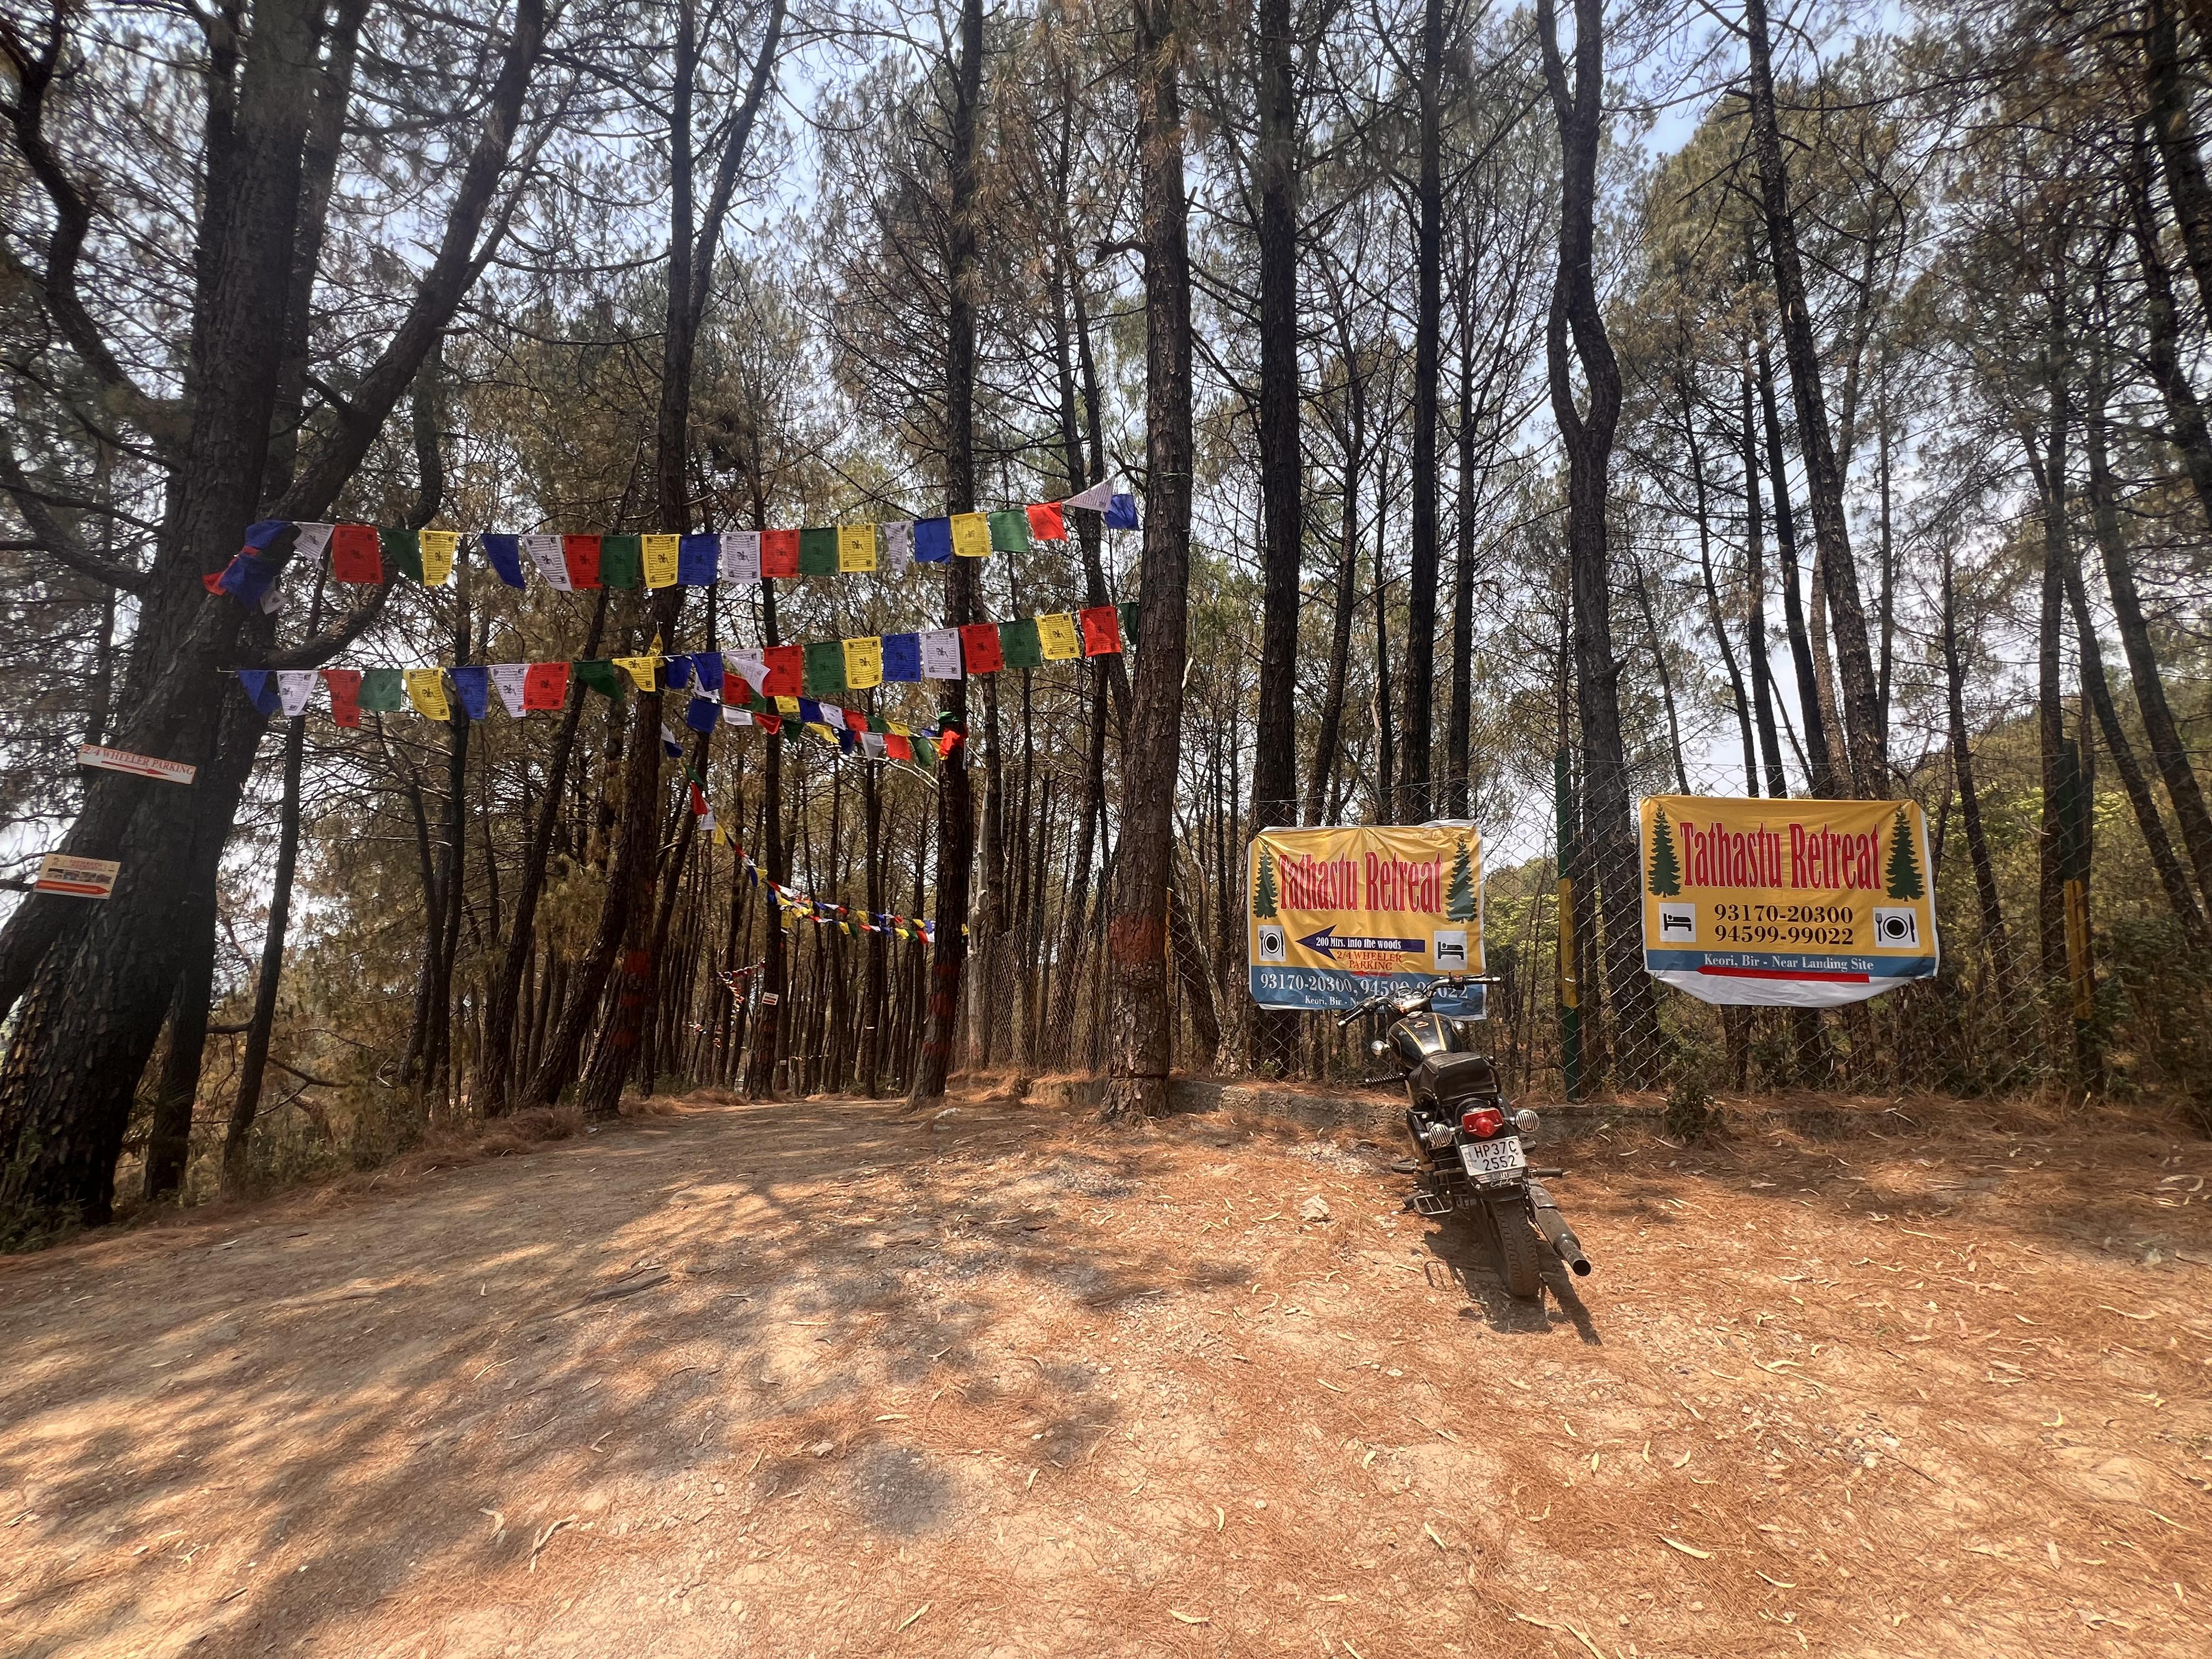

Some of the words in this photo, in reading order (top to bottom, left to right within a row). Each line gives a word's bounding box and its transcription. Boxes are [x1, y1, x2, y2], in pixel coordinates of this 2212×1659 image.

[83, 746, 100, 756] 2/4
[103, 749, 149, 765] WHEELER
[152, 760, 194, 775] PARKING
[1680, 822, 1782, 888] Tathastu
[1789, 823, 1881, 890] Retreat
[1278, 851, 1358, 911] Tathastu
[1365, 851, 1442, 913] Retreat
[1715, 904, 1853, 924] 93170-20300
[1316, 936, 1329, 947] 200
[1330, 937, 1345, 947] Mtrs.
[1347, 938, 1362, 948] into
[1364, 938, 1376, 949] the
[1378, 940, 1401, 950] woods
[1715, 925, 1853, 945] 94599-99022
[1336, 951, 1351, 960] 2/4
[1353, 951, 1402, 962] WHEELER
[1348, 960, 1392, 970] PARKING
[1703, 953, 1738, 968] Keori,
[1742, 955, 1760, 967] Bir
[1771, 956, 1798, 968] Near
[1802, 956, 1848, 972] Landing
[1851, 957, 1874, 970] Site
[1261, 973, 1358, 996] 93170-20300,
[1305, 995, 1327, 1005] Keori,
[1329, 996, 1342, 1006] Bir
[1474, 1141, 1516, 1158] HP37C
[1483, 1155, 1517, 1171] 2552
